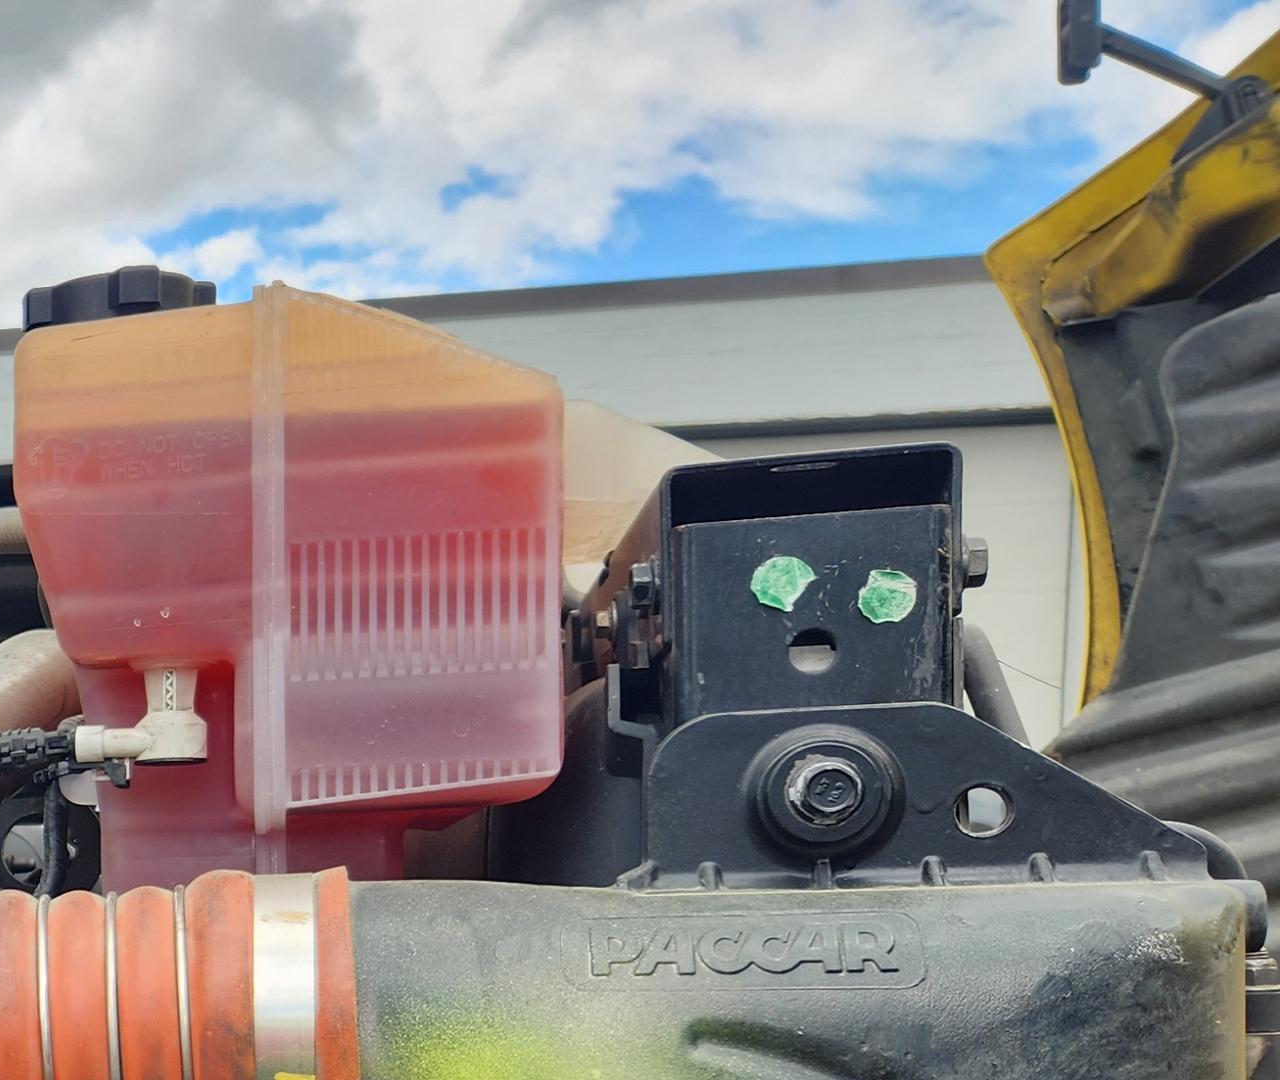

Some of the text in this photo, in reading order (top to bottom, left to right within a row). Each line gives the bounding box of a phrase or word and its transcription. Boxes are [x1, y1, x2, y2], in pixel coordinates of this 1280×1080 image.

[140, 433, 178, 454] NOT
[99, 453, 208, 482] WHEN HOT
[587, 921, 900, 977] PACCAR
